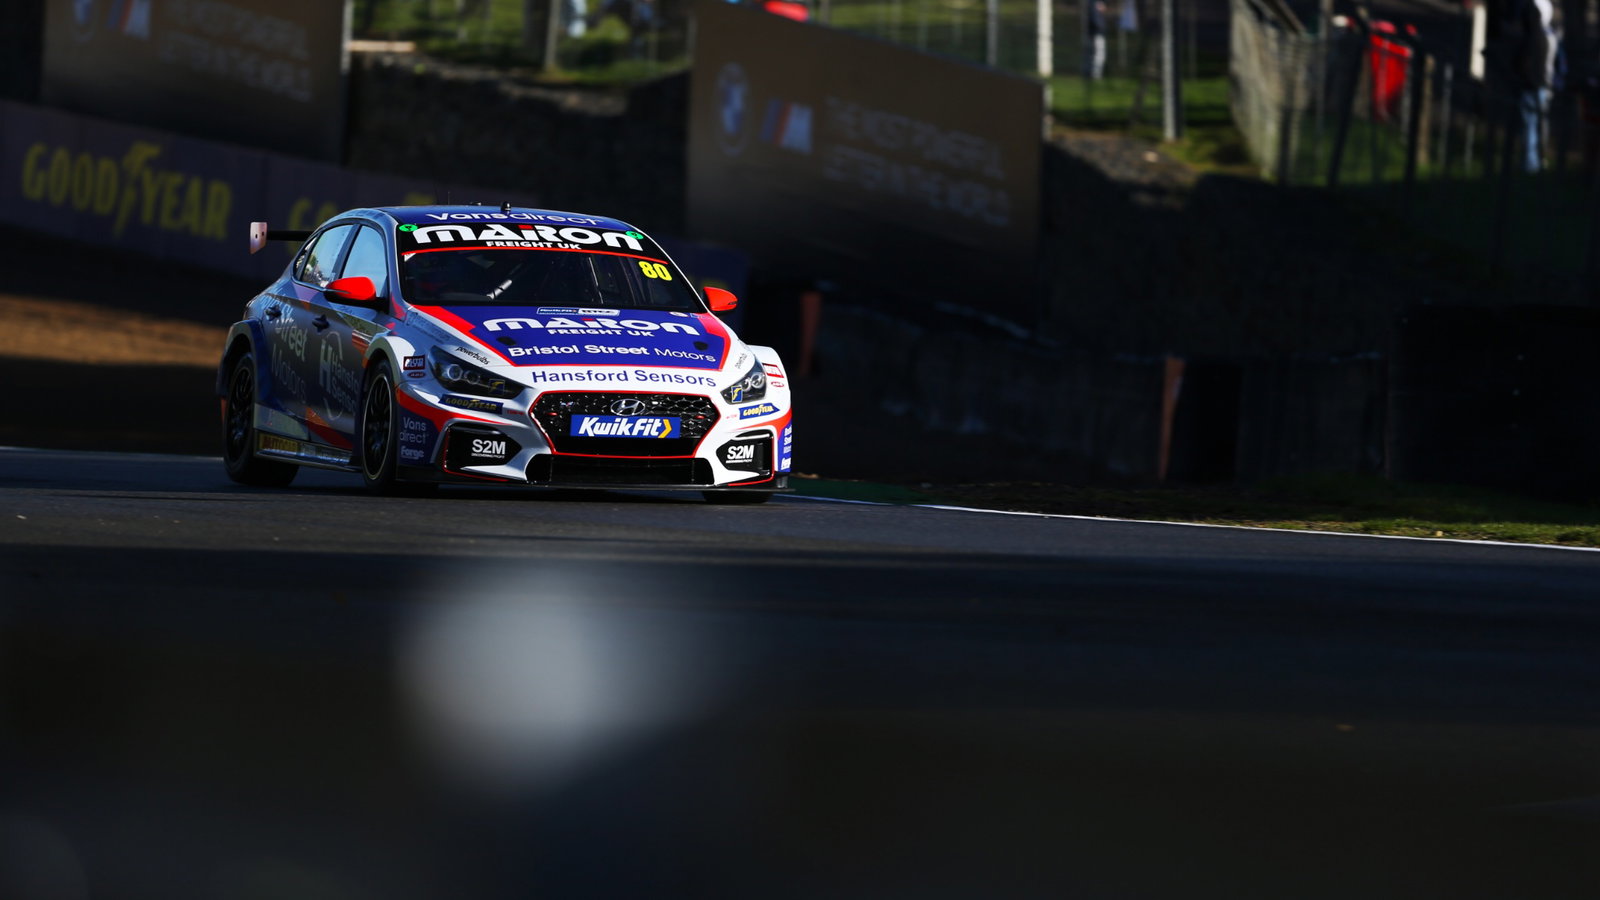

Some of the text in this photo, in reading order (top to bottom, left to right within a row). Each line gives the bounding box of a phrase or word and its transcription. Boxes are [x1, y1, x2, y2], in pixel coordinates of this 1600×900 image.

[22, 140, 232, 240] GOODYEAR
[486, 240, 583, 250] FREIGHT UK
[638, 260, 672, 281] 80
[547, 328, 621, 336] FREIGHT
[455, 346, 490, 365] powerbulbs
[508, 344, 717, 363] Bristol Street Motors
[532, 369, 717, 387] Hansford Sensors
[445, 397, 498, 412] GOODYEAR
[403, 416, 427, 431] Vans
[400, 431, 427, 445] direct
[471, 439, 506, 455] S2M
[727, 445, 754, 460] S2M
